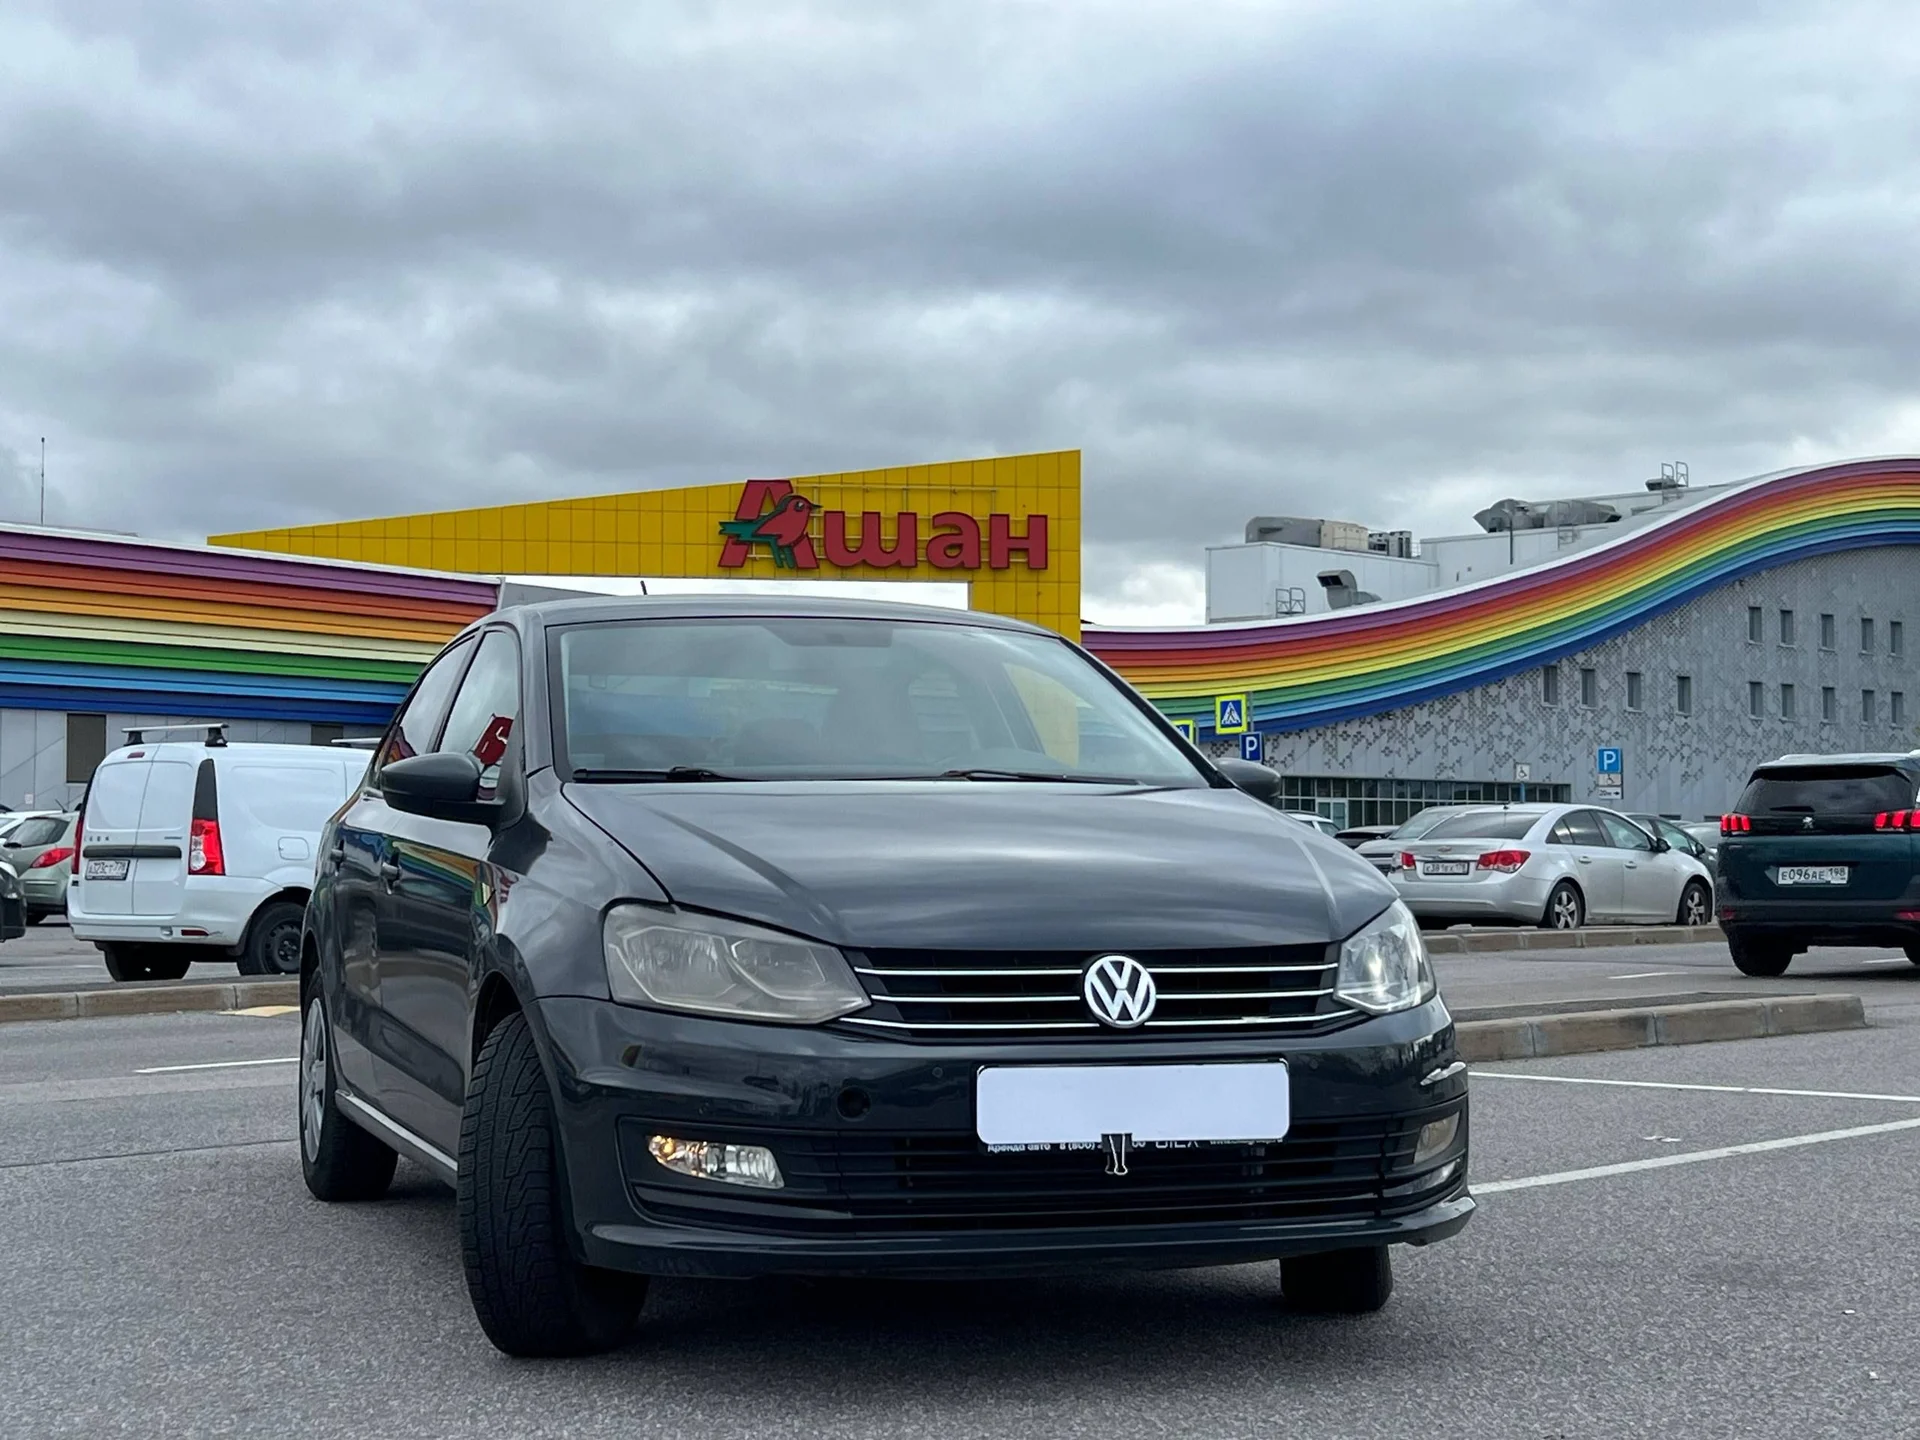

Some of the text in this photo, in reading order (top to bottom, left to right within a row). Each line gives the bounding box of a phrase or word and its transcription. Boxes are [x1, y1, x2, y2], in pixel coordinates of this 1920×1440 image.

[718, 479, 1048, 570] Ашан
[1245, 736, 1258, 760] P
[1603, 750, 1616, 771] P
[1084, 955, 1156, 1028] VW
